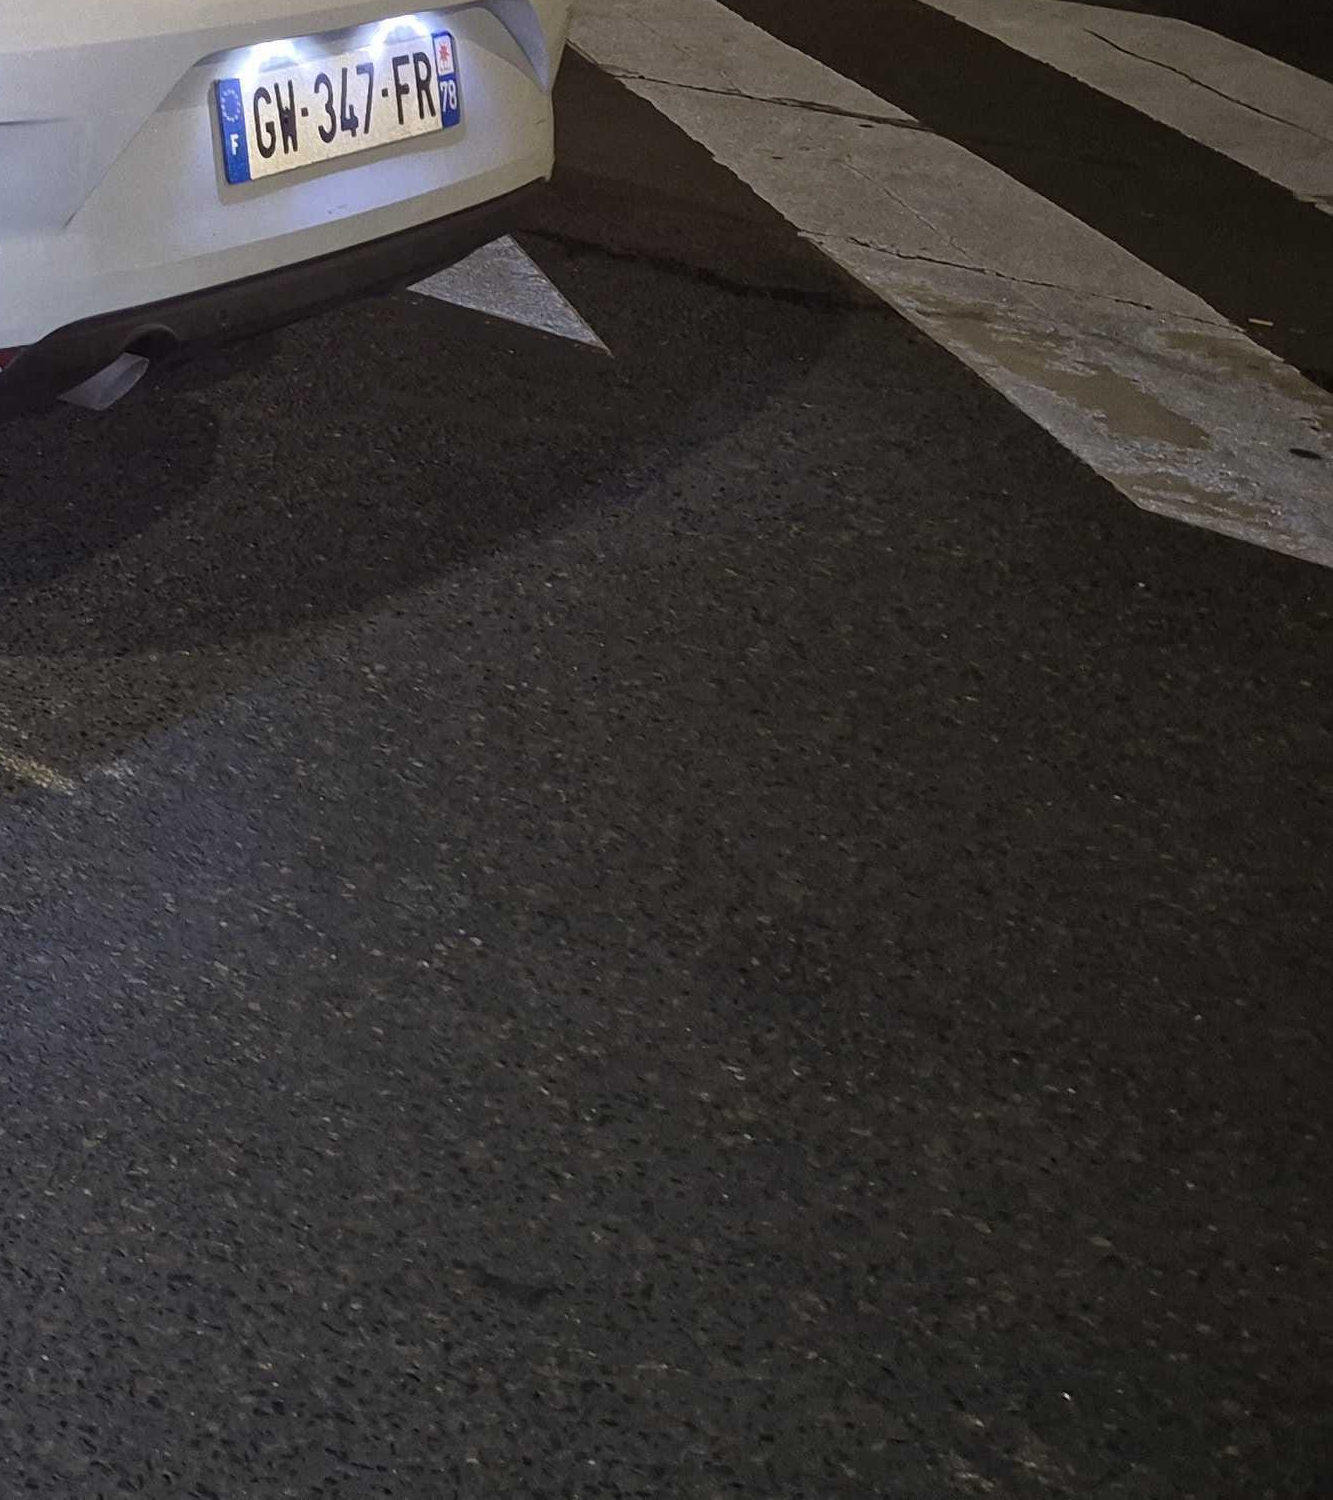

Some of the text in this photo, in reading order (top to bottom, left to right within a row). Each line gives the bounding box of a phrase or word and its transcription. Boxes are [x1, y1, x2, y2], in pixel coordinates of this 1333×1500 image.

[229, 51, 457, 160] F GW-347-FR 78
